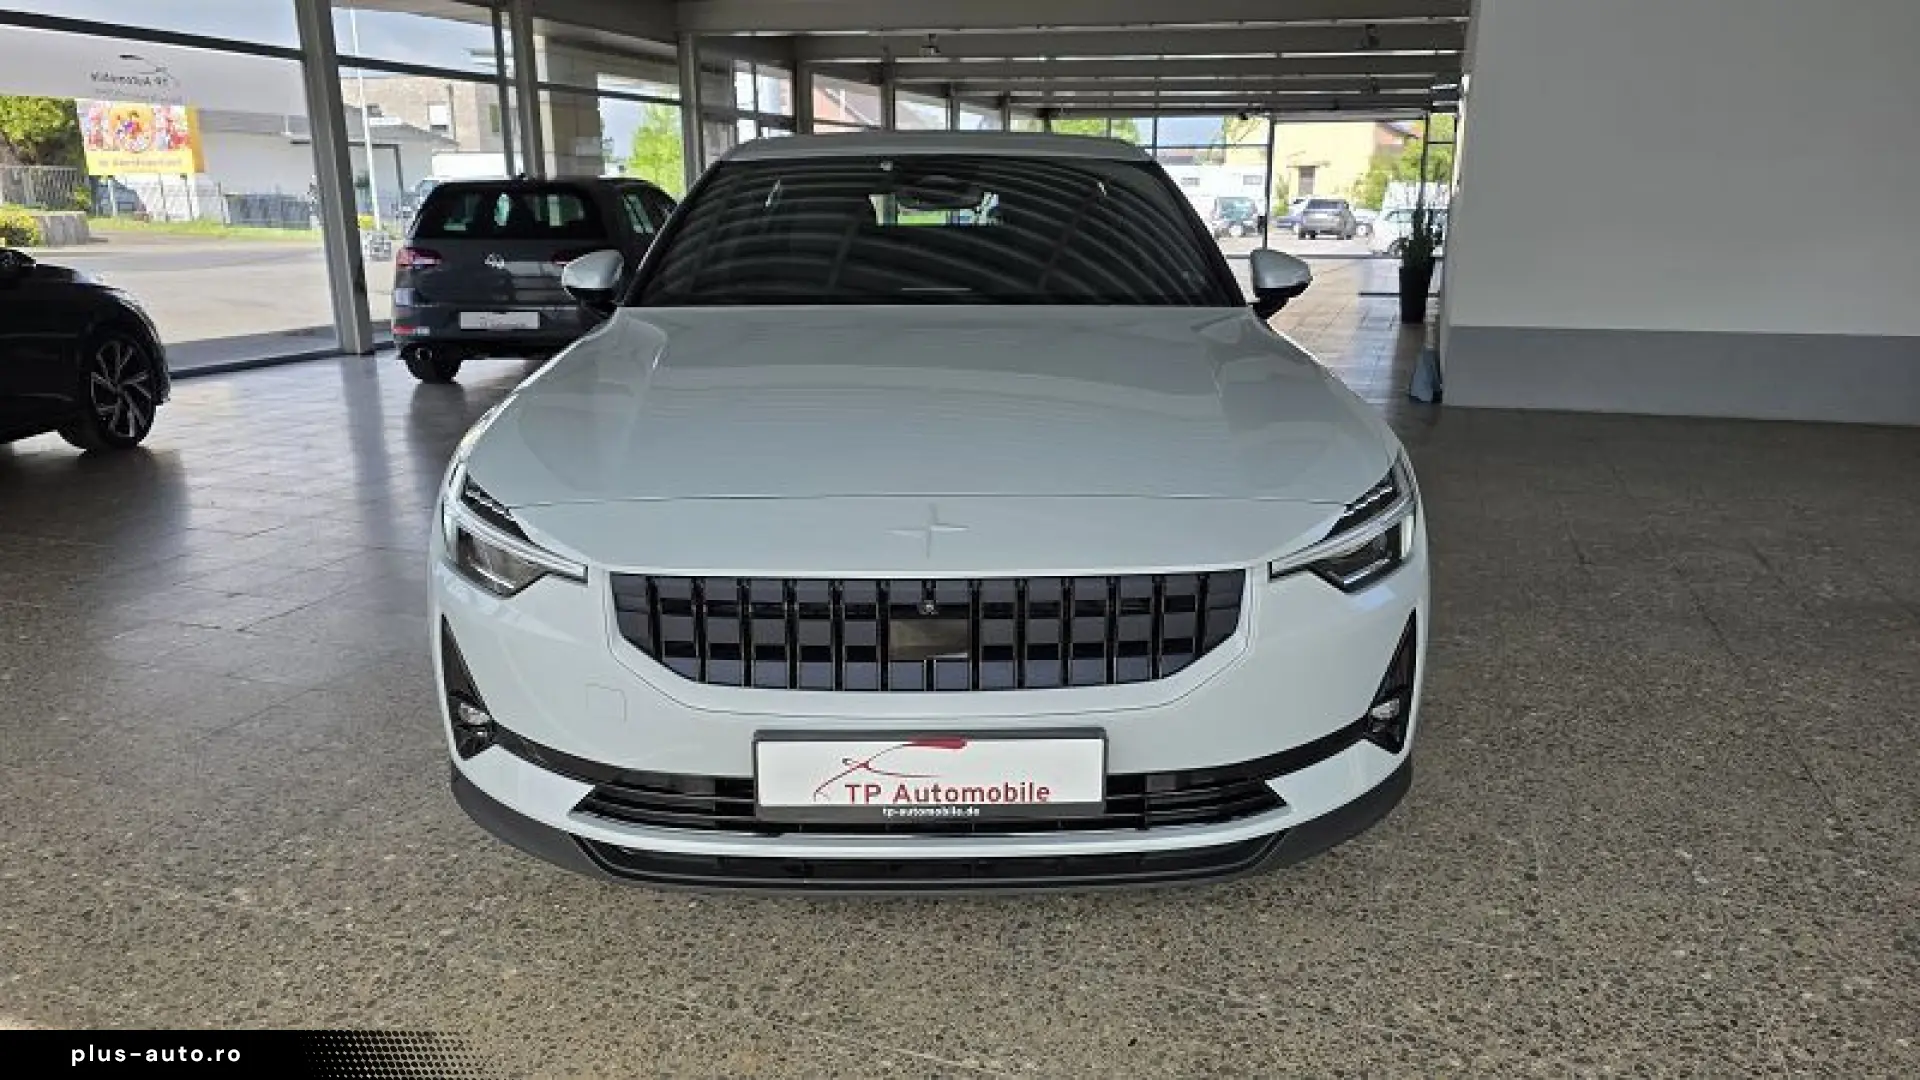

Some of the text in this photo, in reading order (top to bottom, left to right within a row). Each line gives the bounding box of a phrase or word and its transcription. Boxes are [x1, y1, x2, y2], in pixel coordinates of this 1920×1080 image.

[844, 781, 1051, 804] TP Automobile
[882, 804, 981, 818] tp-automobile.de
